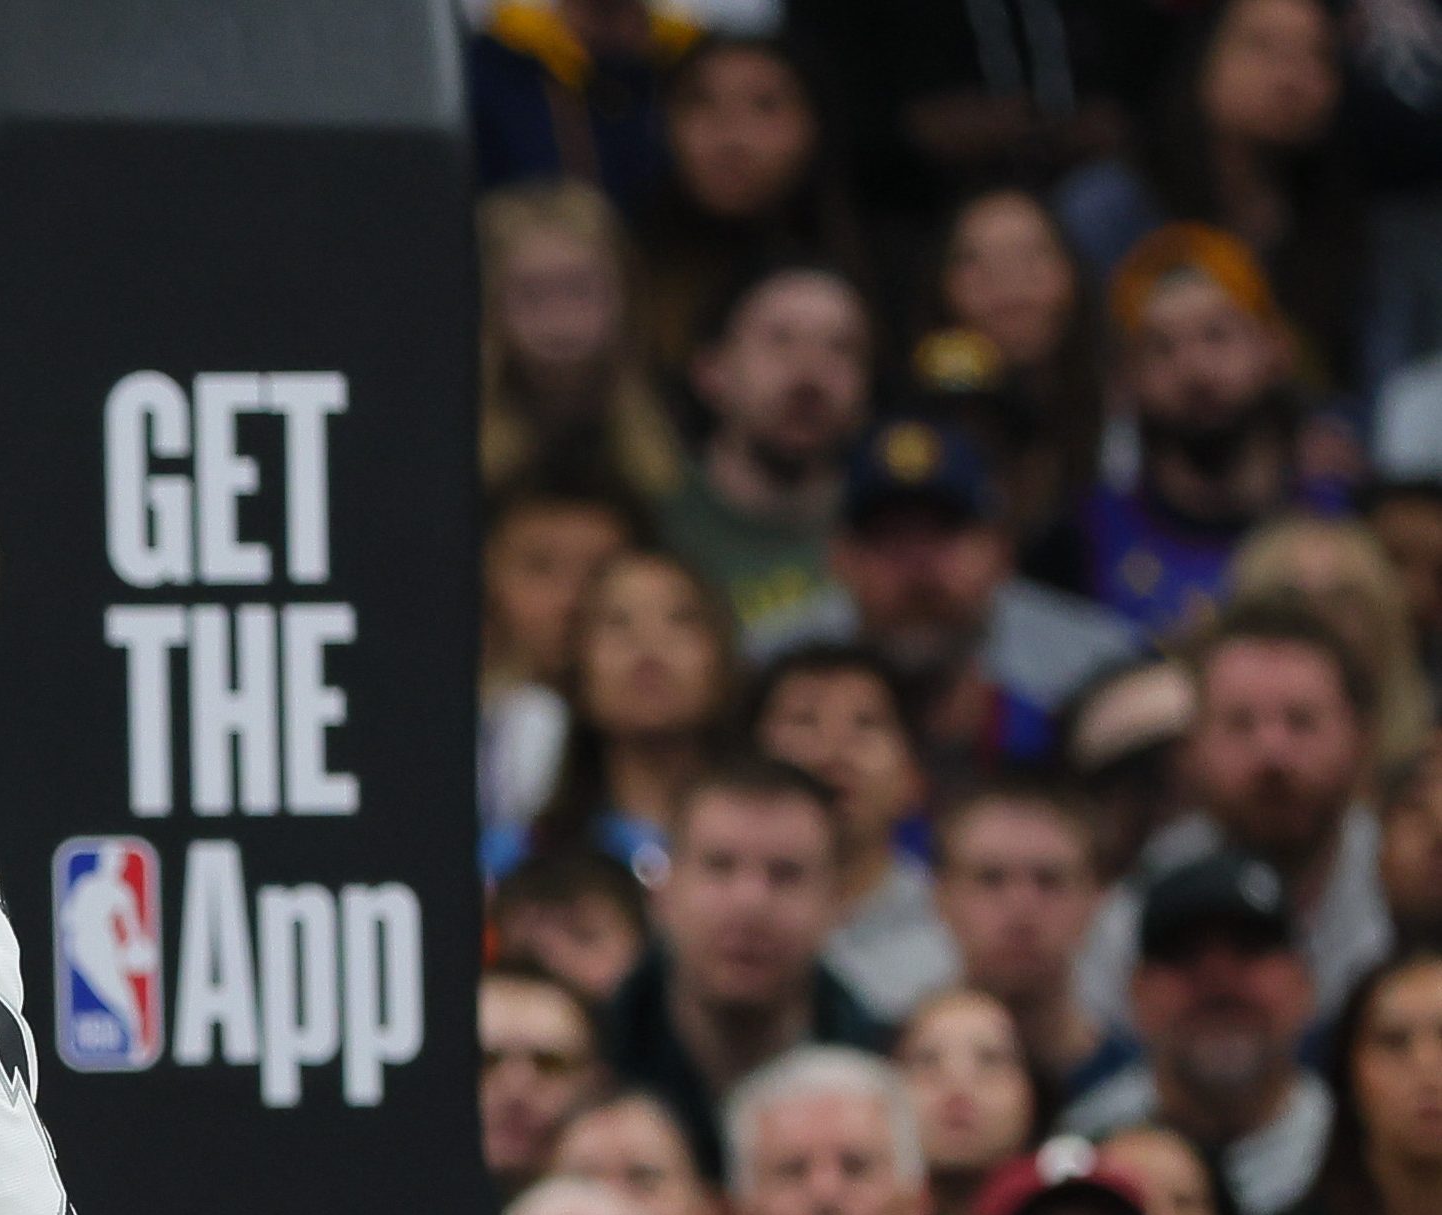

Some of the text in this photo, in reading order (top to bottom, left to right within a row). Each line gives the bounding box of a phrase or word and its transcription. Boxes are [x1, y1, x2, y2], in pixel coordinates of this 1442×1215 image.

[104, 369, 348, 588] GET
[104, 602, 360, 817] THE
[172, 838, 424, 1108] App
